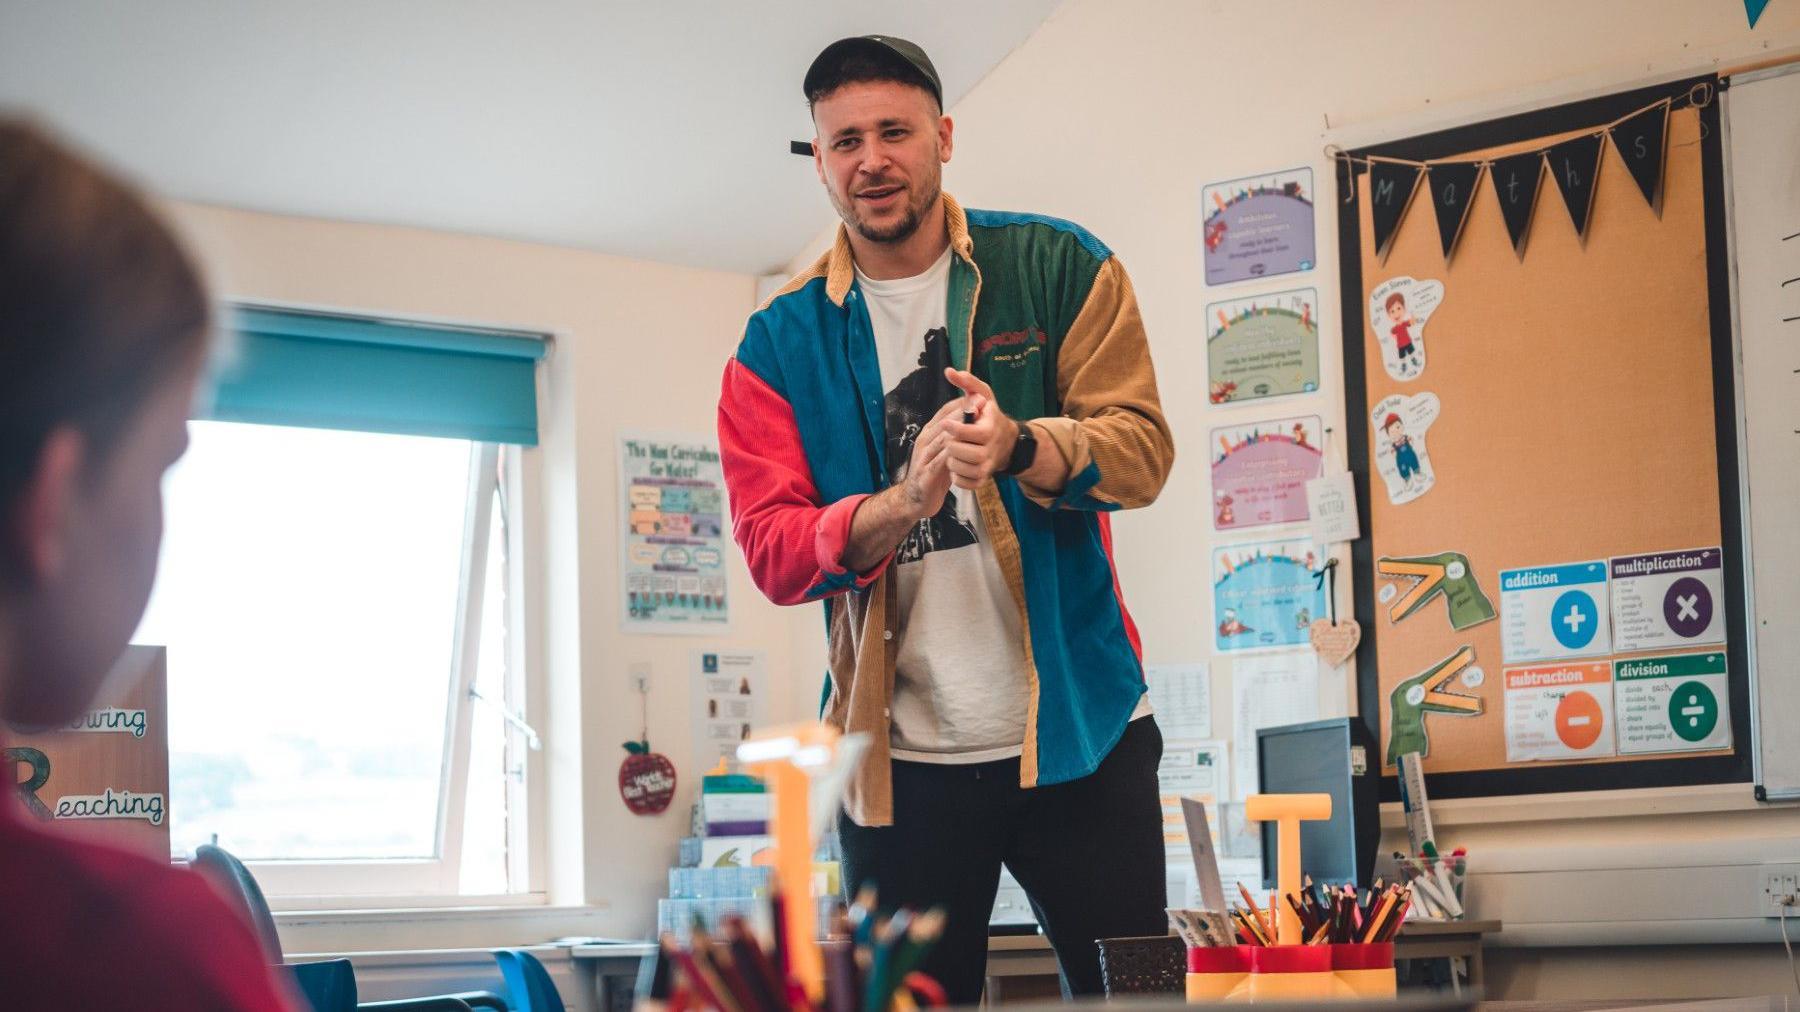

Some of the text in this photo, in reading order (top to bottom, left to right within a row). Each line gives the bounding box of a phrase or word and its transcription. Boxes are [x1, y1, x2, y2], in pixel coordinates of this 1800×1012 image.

[1615, 554, 1702, 575] multiplication
[1505, 570, 1559, 588] addition
[1511, 669, 1583, 687] subtraction
[1620, 661, 1668, 678] division
